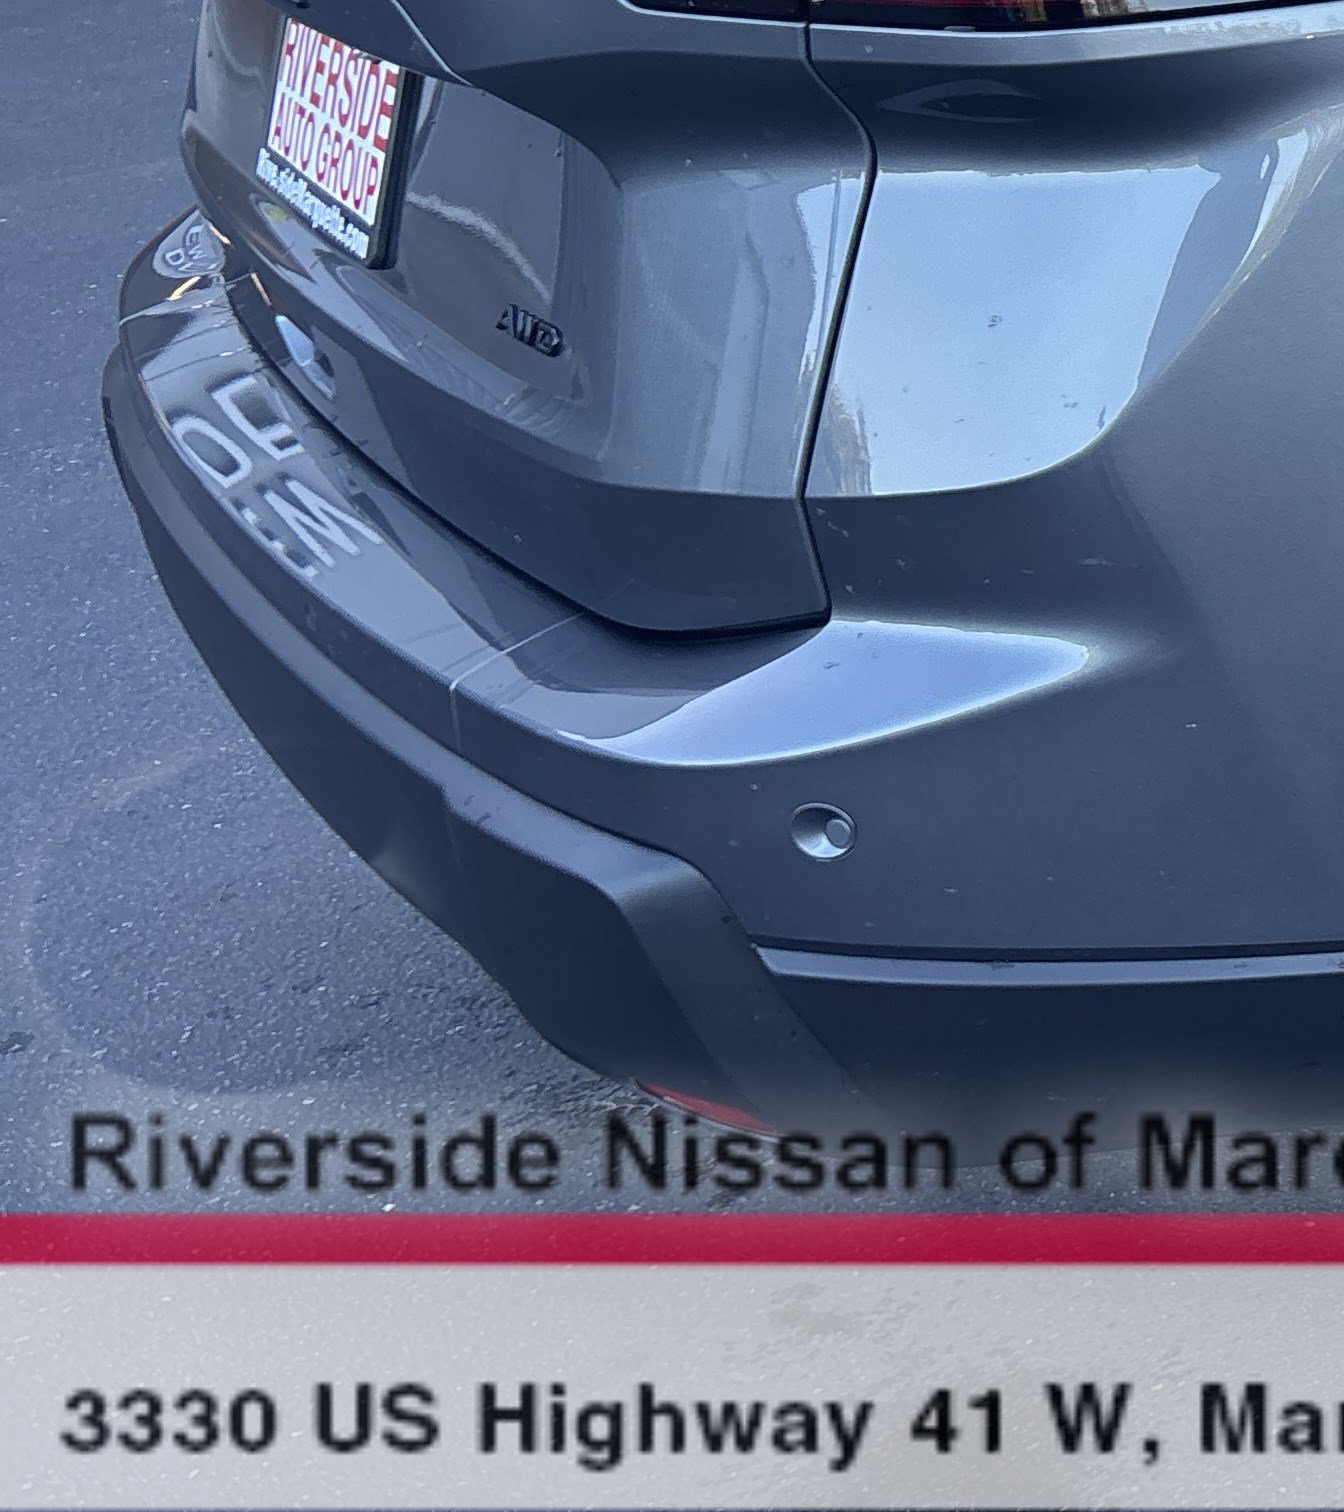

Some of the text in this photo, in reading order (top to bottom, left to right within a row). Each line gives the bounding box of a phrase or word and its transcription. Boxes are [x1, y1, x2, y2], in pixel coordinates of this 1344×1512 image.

[278, 20, 400, 155] RIVERSIDE
[271, 91, 379, 216] AUTO GROUP
[493, 302, 566, 358] AWD
